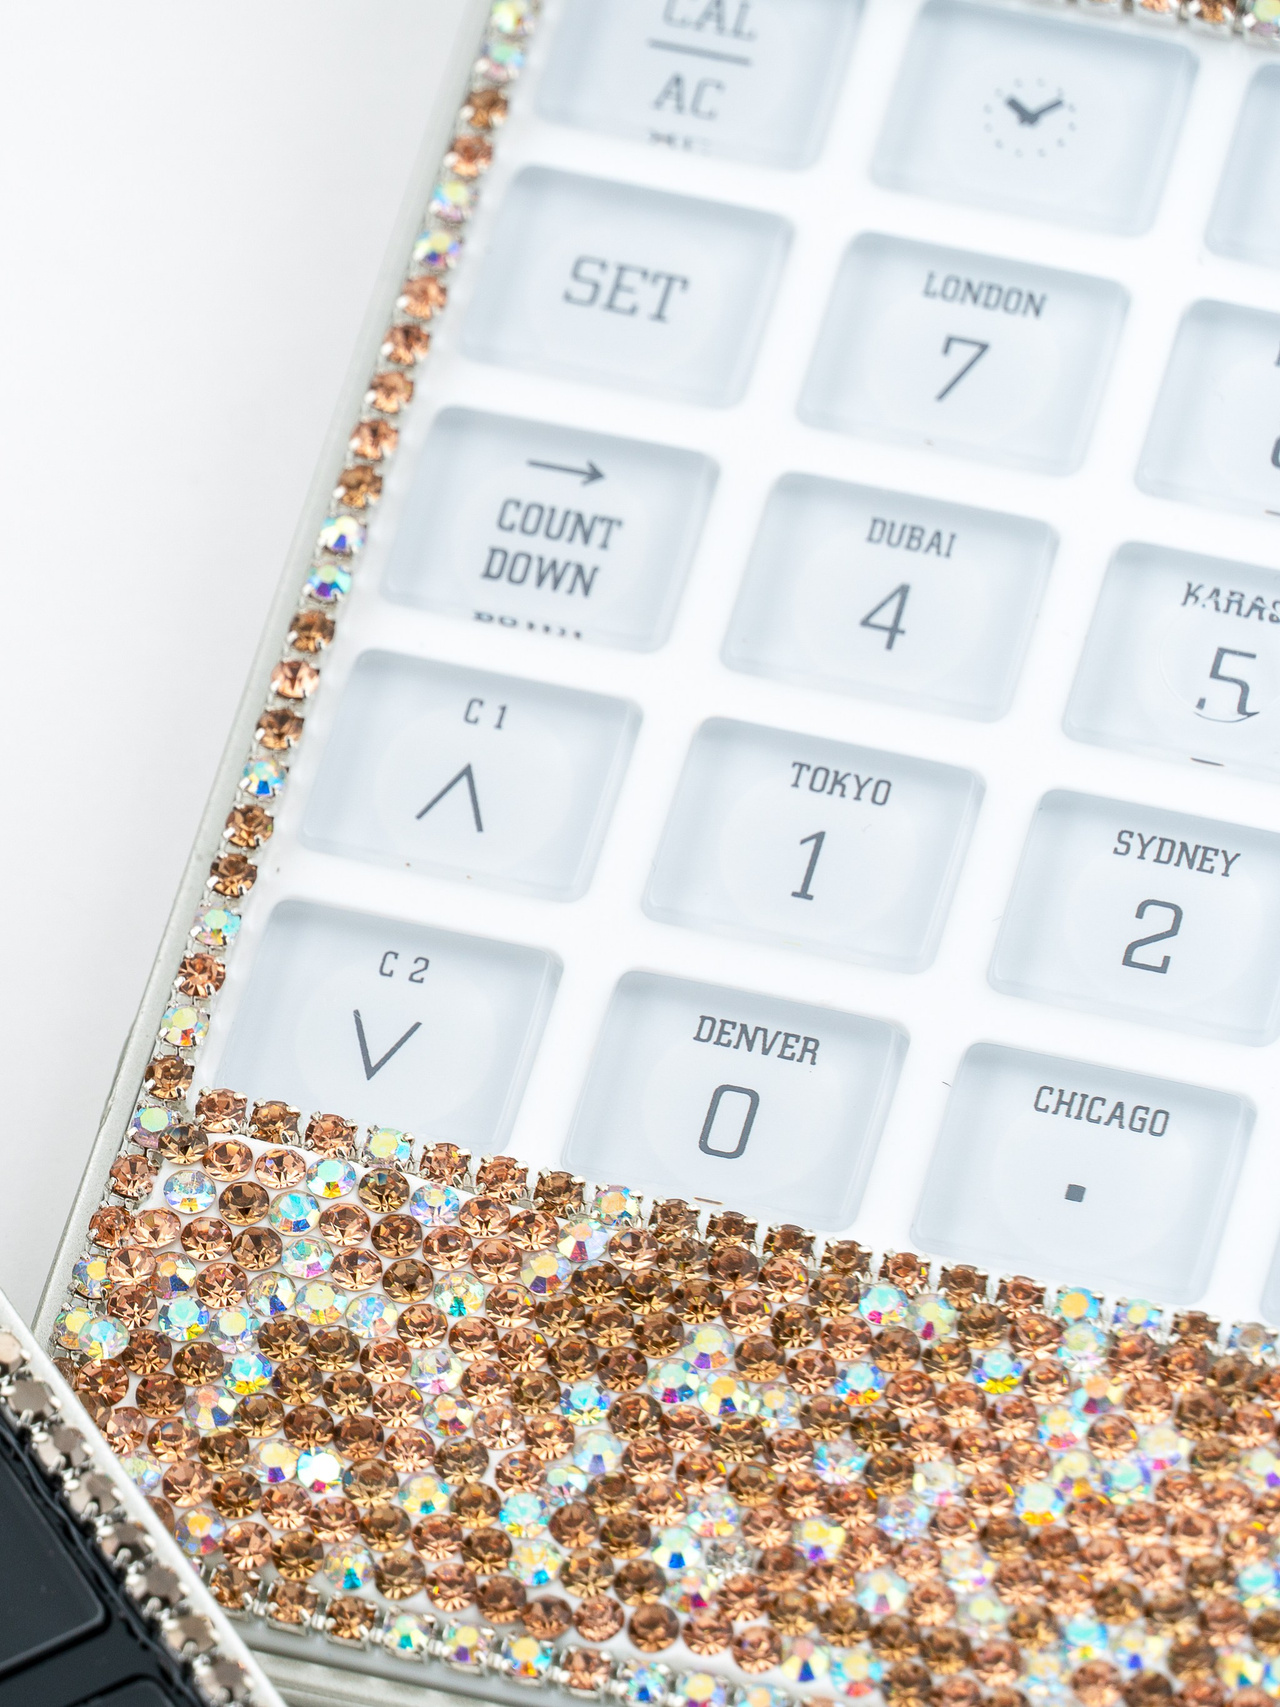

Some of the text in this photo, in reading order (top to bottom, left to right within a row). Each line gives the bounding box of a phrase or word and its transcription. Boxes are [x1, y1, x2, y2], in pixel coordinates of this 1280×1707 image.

[661, 0, 757, 42] CAL
[653, 72, 725, 120] AC
[562, 255, 690, 324] SET
[923, 270, 1048, 318] LONDON
[935, 335, 990, 402] 7
[495, 498, 623, 550] COUNT
[866, 516, 957, 559] DUBAI
[481, 546, 600, 598] DOWN
[859, 583, 911, 650] 4
[1195, 646, 1260, 723] 5
[790, 761, 893, 807] TOKYO
[790, 830, 826, 901] 1
[1112, 829, 1242, 878] SYDNEY
[1121, 898, 1184, 975] 2
[692, 1014, 820, 1066] DENVER
[698, 1083, 760, 1160] 0
[1033, 1085, 1171, 1138] CHICAGO
